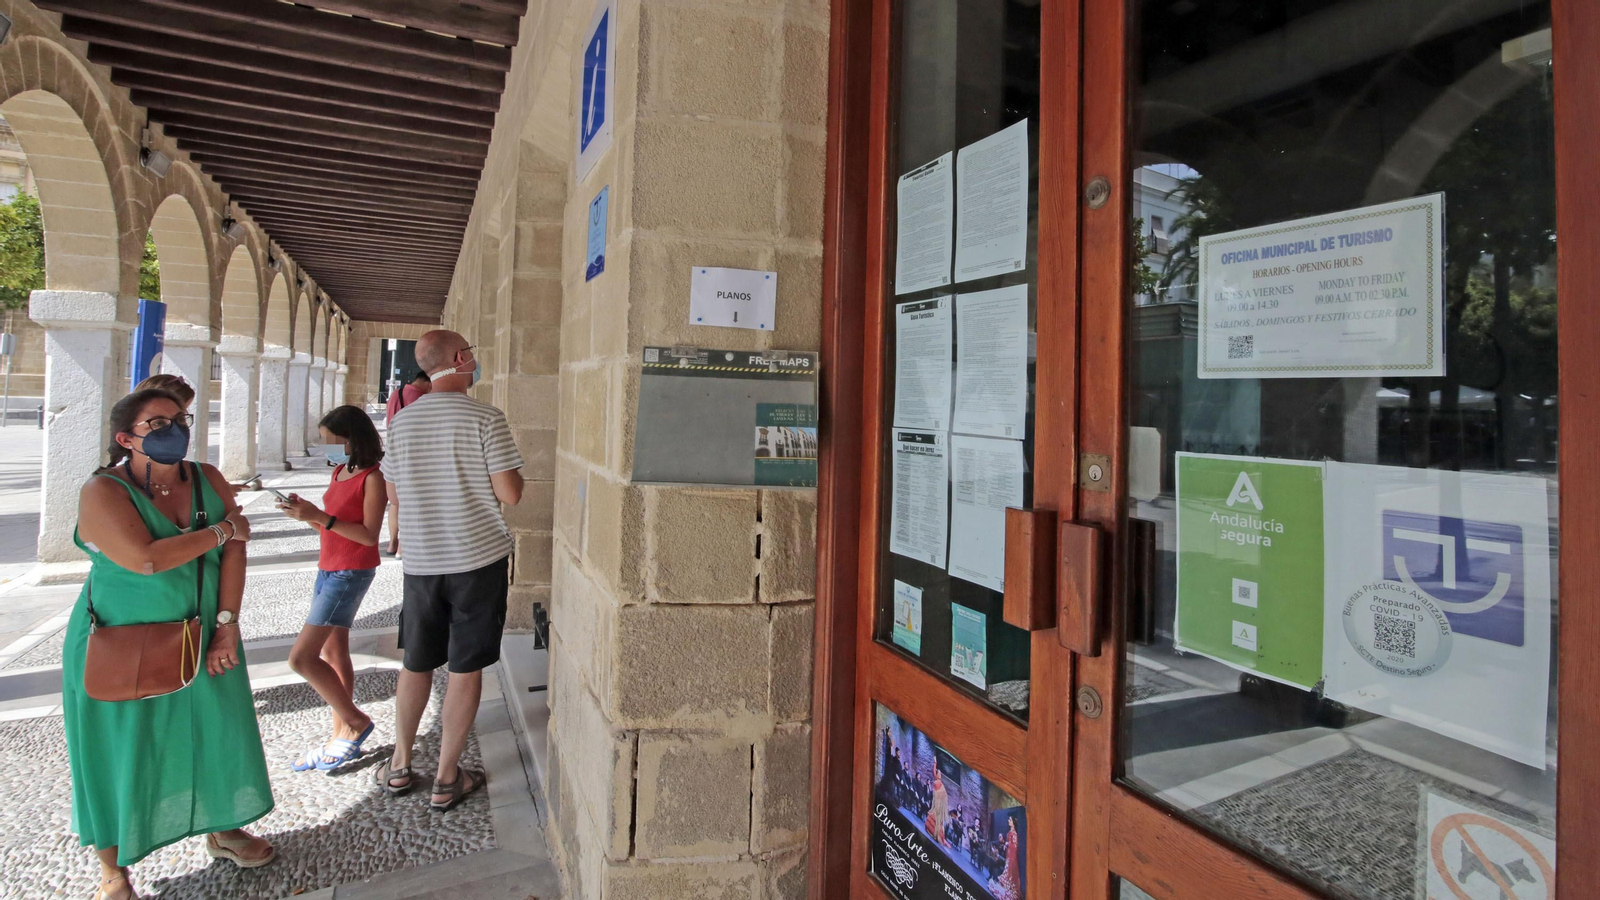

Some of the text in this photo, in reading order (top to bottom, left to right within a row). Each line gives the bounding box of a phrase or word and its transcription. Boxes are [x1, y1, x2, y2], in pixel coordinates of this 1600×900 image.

[1221, 228, 1393, 265] OFICINA MUNICIPAL DE TURISMO
[1252, 265, 1291, 279] HORARIOS
[1296, 260, 1332, 275] OPENING
[1333, 256, 1364, 269] HOURS
[1318, 271, 1405, 291] MONDAY TO FRIDAY
[717, 291, 752, 301] PLANOS
[1252, 284, 1295, 297] VIERNES
[1314, 293, 1334, 305] 09.00
[1355, 291, 1367, 302] TO
[1368, 288, 1391, 300] 02.30
[1391, 286, 1410, 299] P.M.
[1227, 303, 1249, 313] 09.00
[1256, 299, 1279, 310] 14.30
[1255, 314, 1306, 327] DOMINGOS
[1306, 314, 1314, 323] Y
[1314, 311, 1362, 323] FESTIVOS
[1362, 306, 1417, 320] CERRADO
[779, 357, 810, 367] MAPS
[1209, 511, 1284, 534] Andalucía
[1220, 529, 1272, 547] segura
[1342, 581, 1450, 636] Buenas Prácticas Avanzadas
[1373, 595, 1421, 612] Preparado
[1369, 604, 1400, 617] COVID
[1412, 613, 1424, 622] 19
[1356, 644, 1375, 663] SCTE
[1375, 660, 1406, 676] Destino
[1406, 664, 1433, 677] Seguro
[1386, 654, 1405, 663] 2020
[944, 883, 962, 900] FLAM
